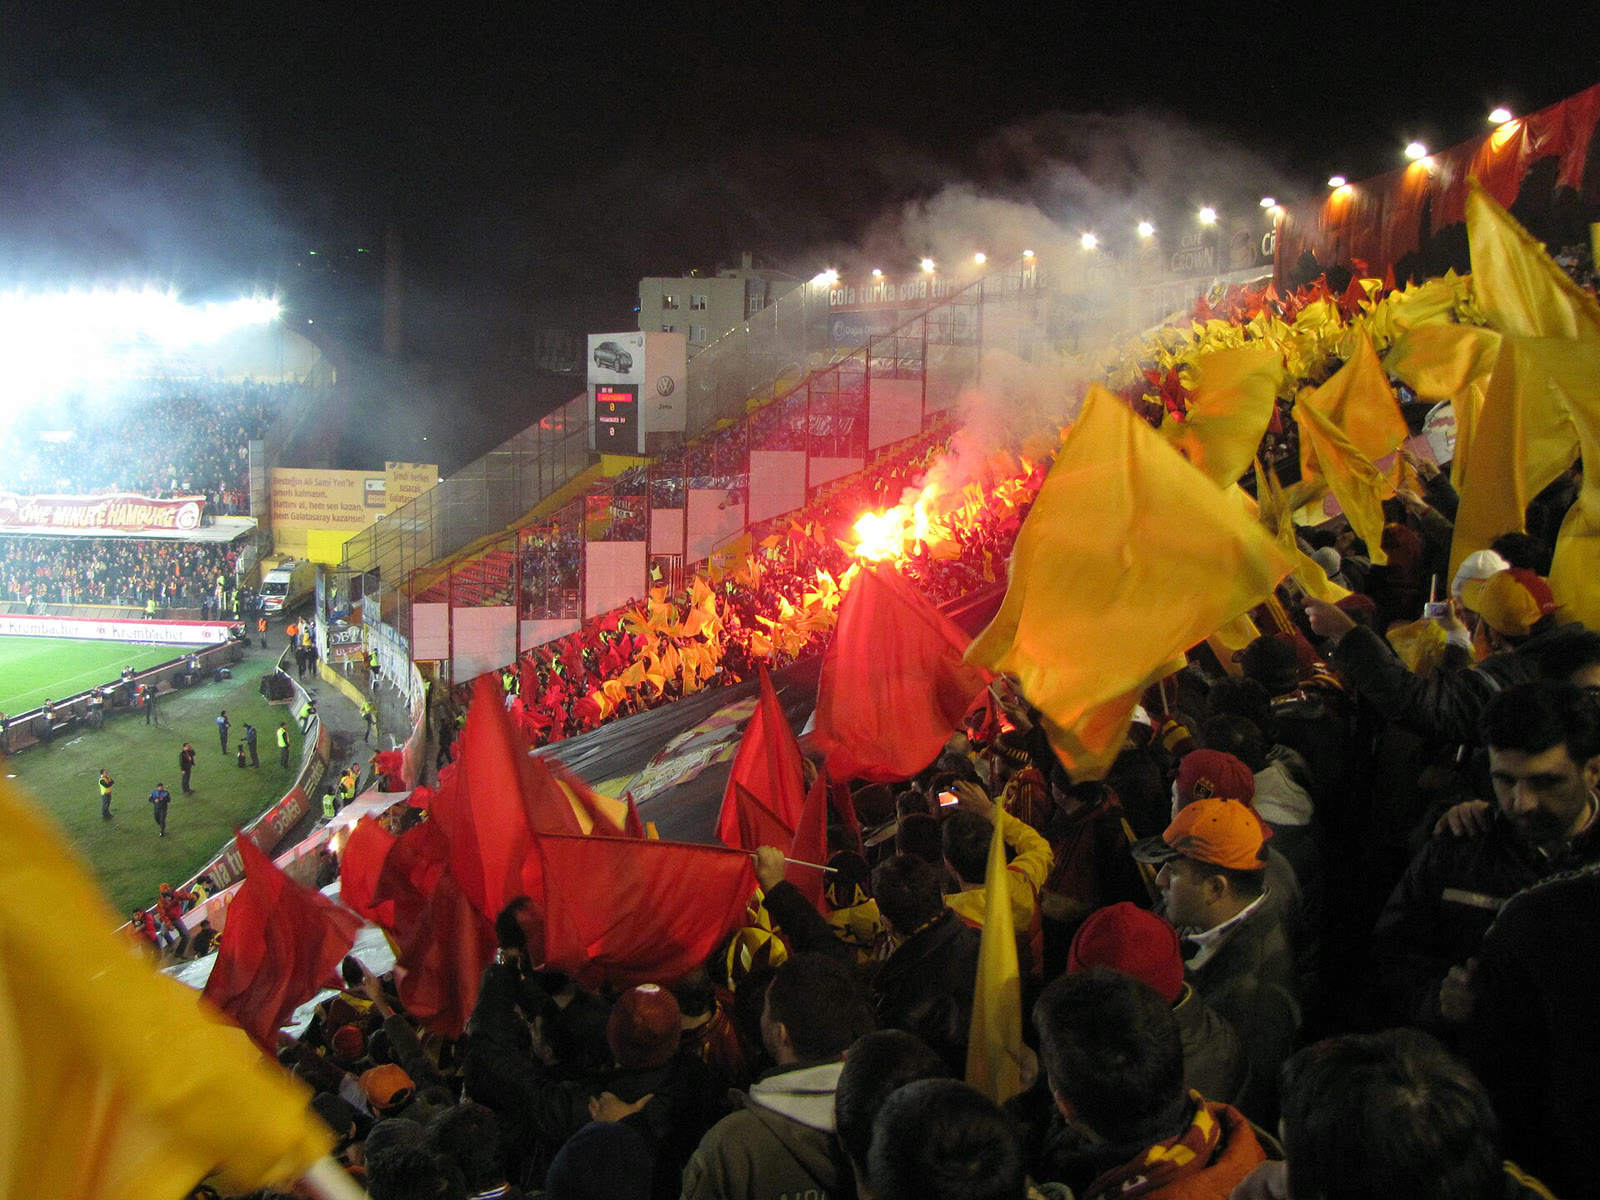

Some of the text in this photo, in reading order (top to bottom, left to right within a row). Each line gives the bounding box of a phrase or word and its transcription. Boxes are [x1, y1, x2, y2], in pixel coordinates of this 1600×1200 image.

[830, 285, 855, 306] cola
[901, 278, 926, 300] cola
[52, 503, 107, 526] MINUTE
[107, 502, 177, 528] HAMBURG
[326, 503, 339, 511] sen
[290, 512, 331, 523] Galatasaray
